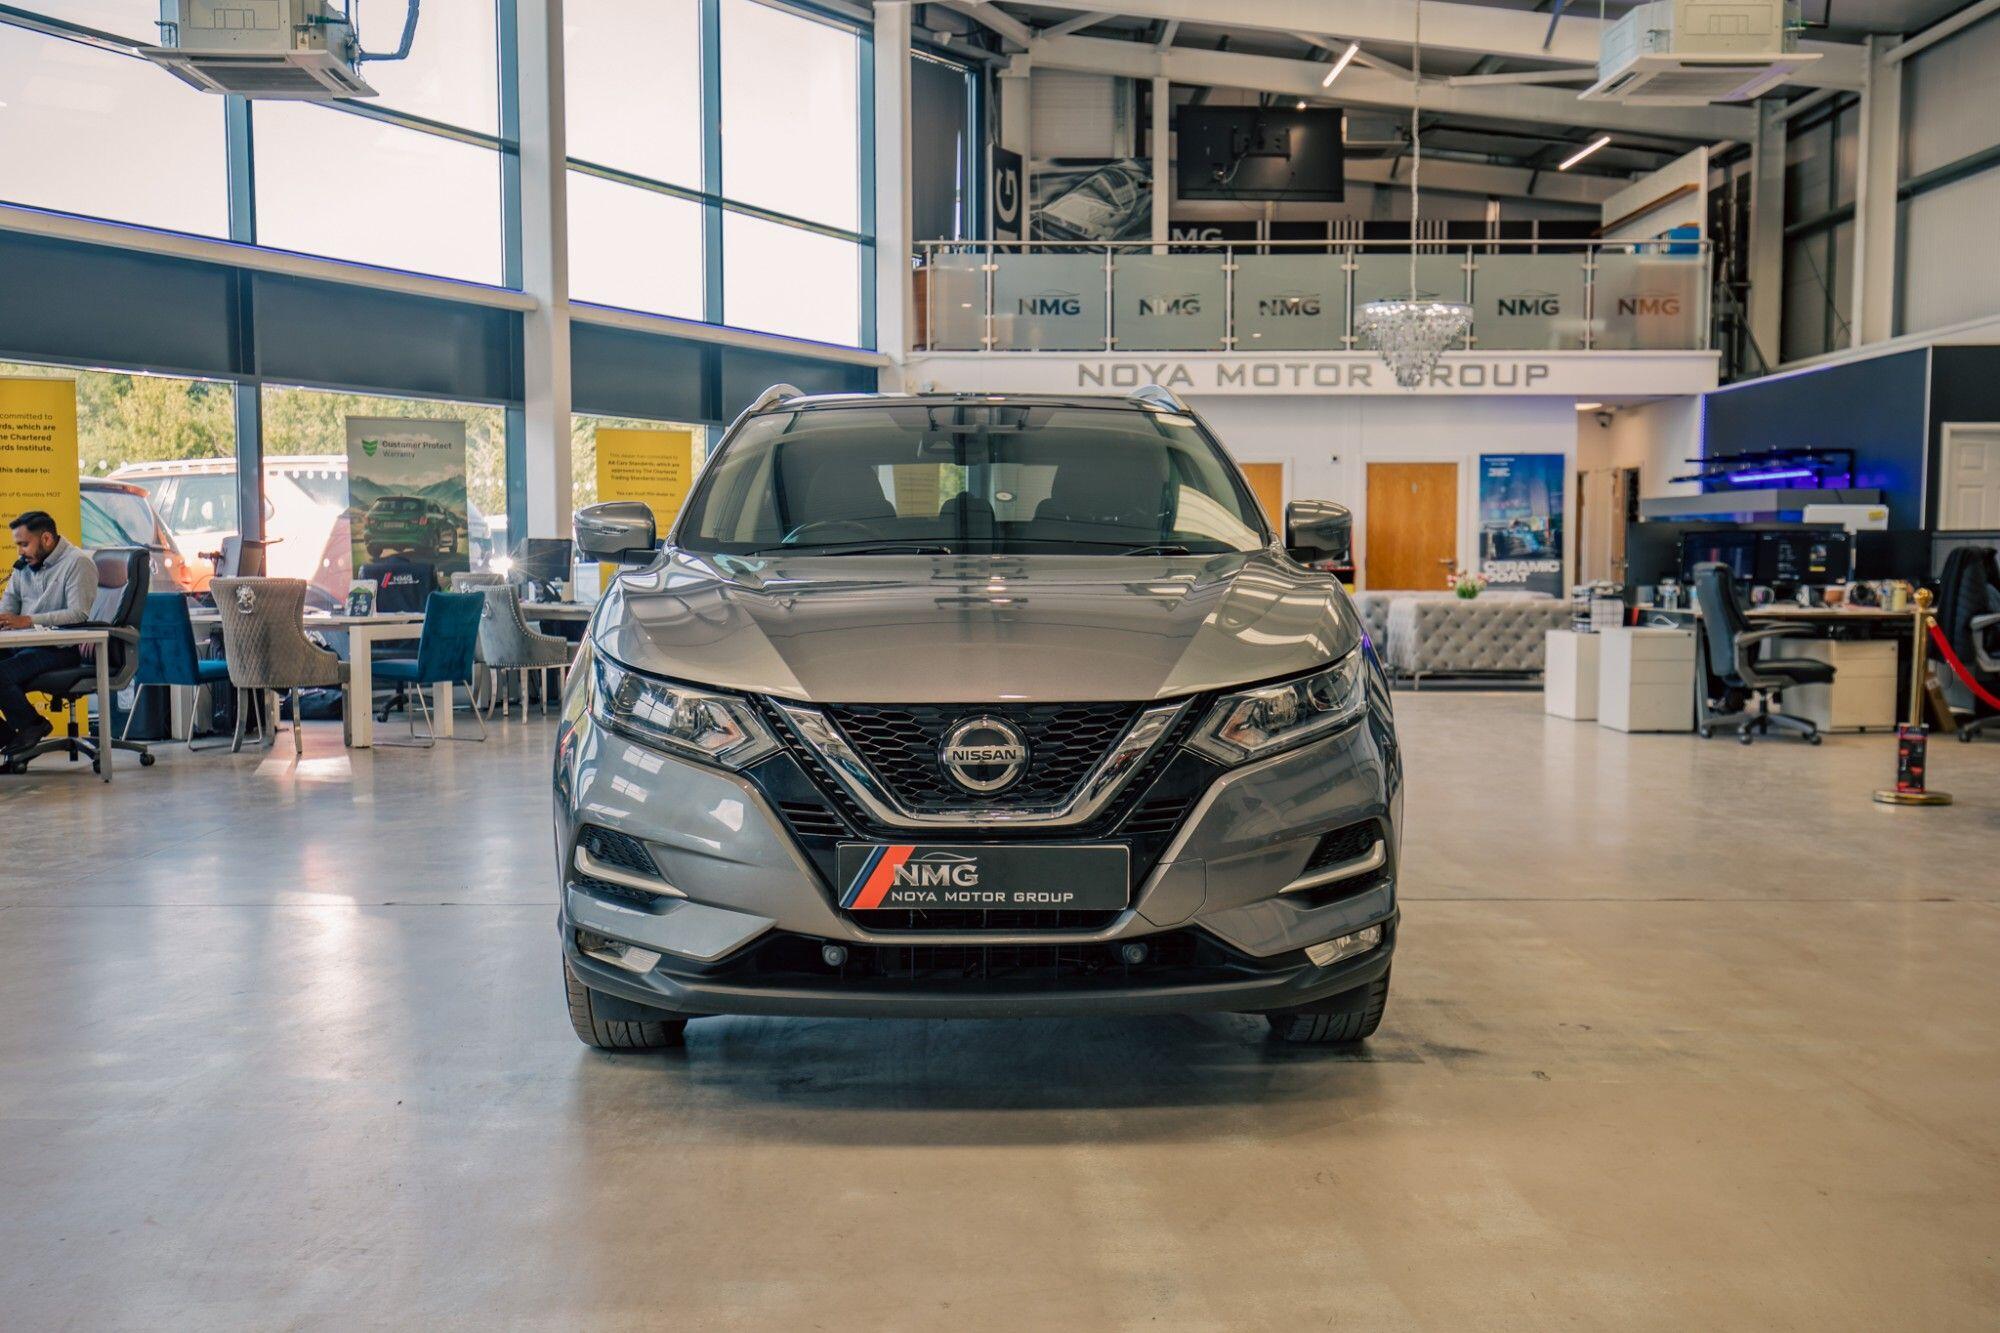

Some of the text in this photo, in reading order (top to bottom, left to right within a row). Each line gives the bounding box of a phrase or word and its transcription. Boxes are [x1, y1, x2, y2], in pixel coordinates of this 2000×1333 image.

[1172, 228, 1224, 248] MG
[1018, 298, 1081, 316] NMG
[1139, 298, 1200, 316] NMG
[1259, 299, 1321, 316] NMG
[1498, 298, 1560, 316] NMG
[1618, 298, 1681, 316] NMG
[1078, 363, 1550, 387] NOYA MOTOR ROUP
[382, 440, 452, 450] Customer Protect
[382, 449, 416, 459] Warranty
[952, 749, 1018, 762] NISSAN
[893, 863, 979, 887] NMG
[891, 891, 1074, 903] NOYA MOTOR GROUP
